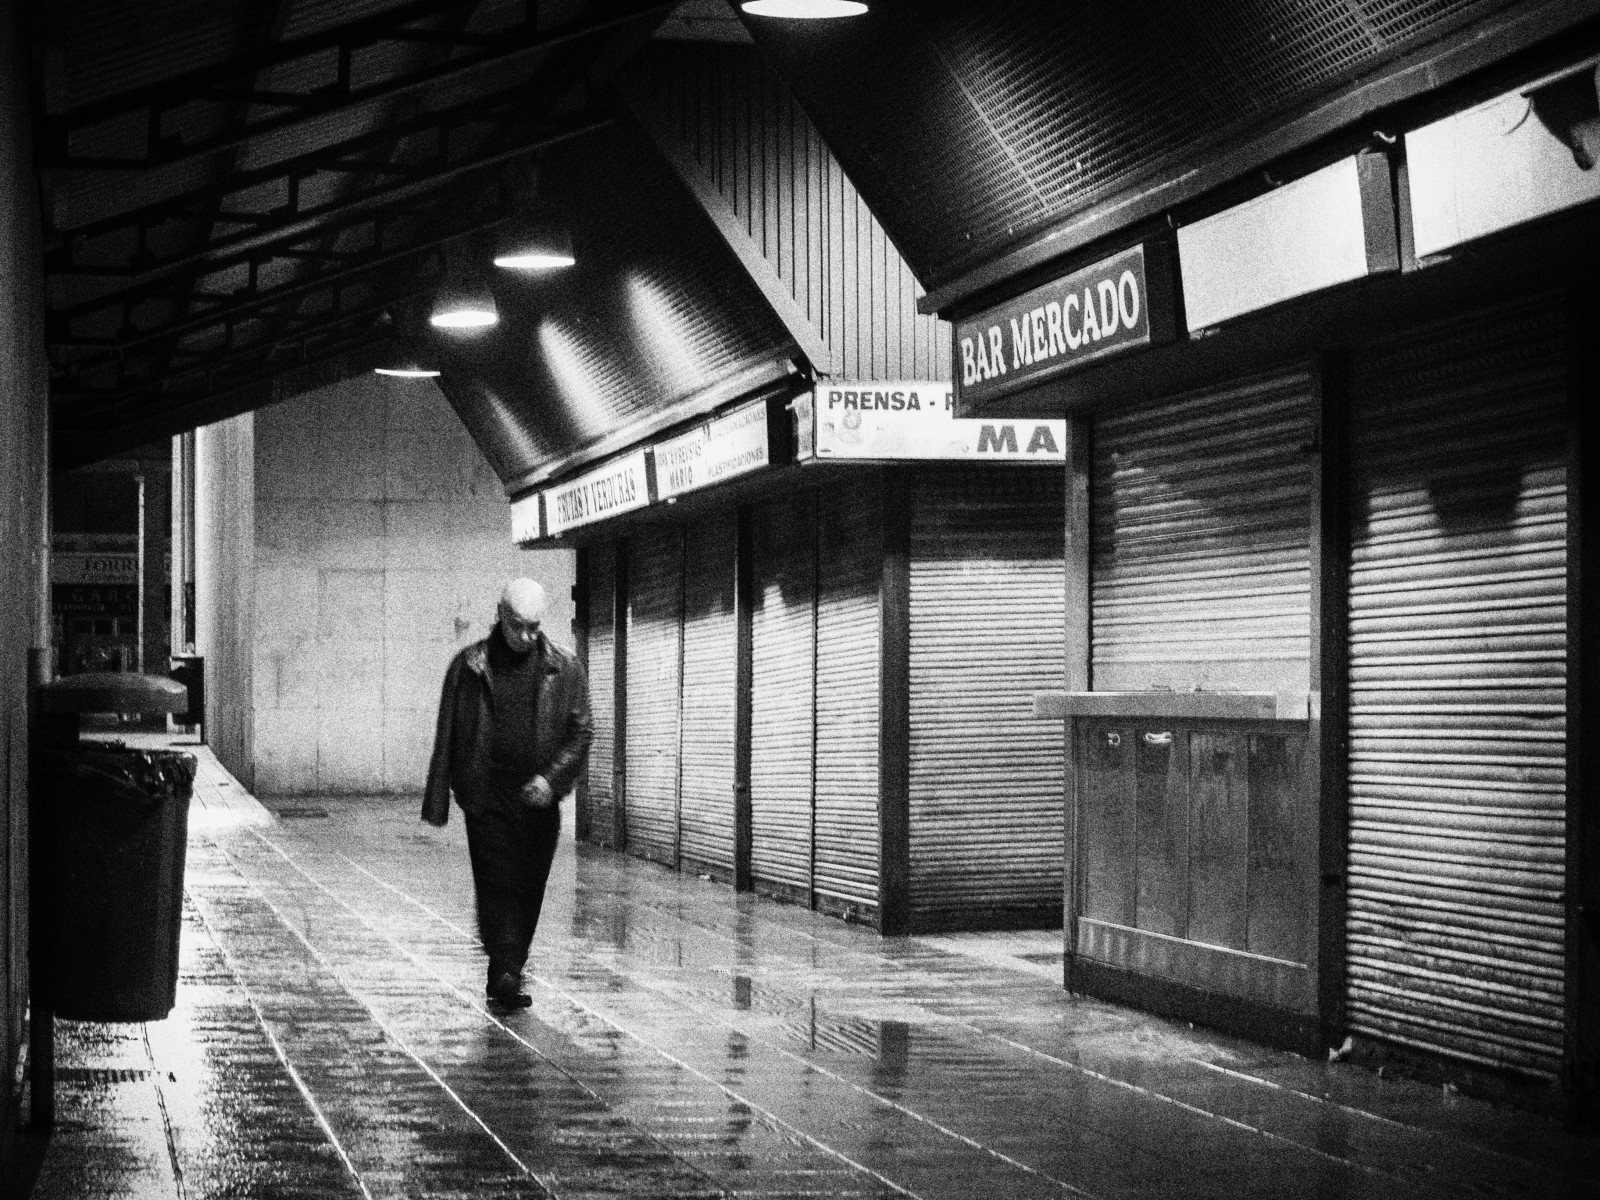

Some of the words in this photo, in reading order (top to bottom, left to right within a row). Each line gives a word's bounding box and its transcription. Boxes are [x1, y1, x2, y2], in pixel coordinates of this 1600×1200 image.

[960, 325, 1007, 387] BAR
[1010, 270, 1140, 369] MERCADO
[828, 390, 922, 412] PRENSA
[556, 485, 584, 524] FRUTAS
[590, 466, 636, 513] VERDURAS
